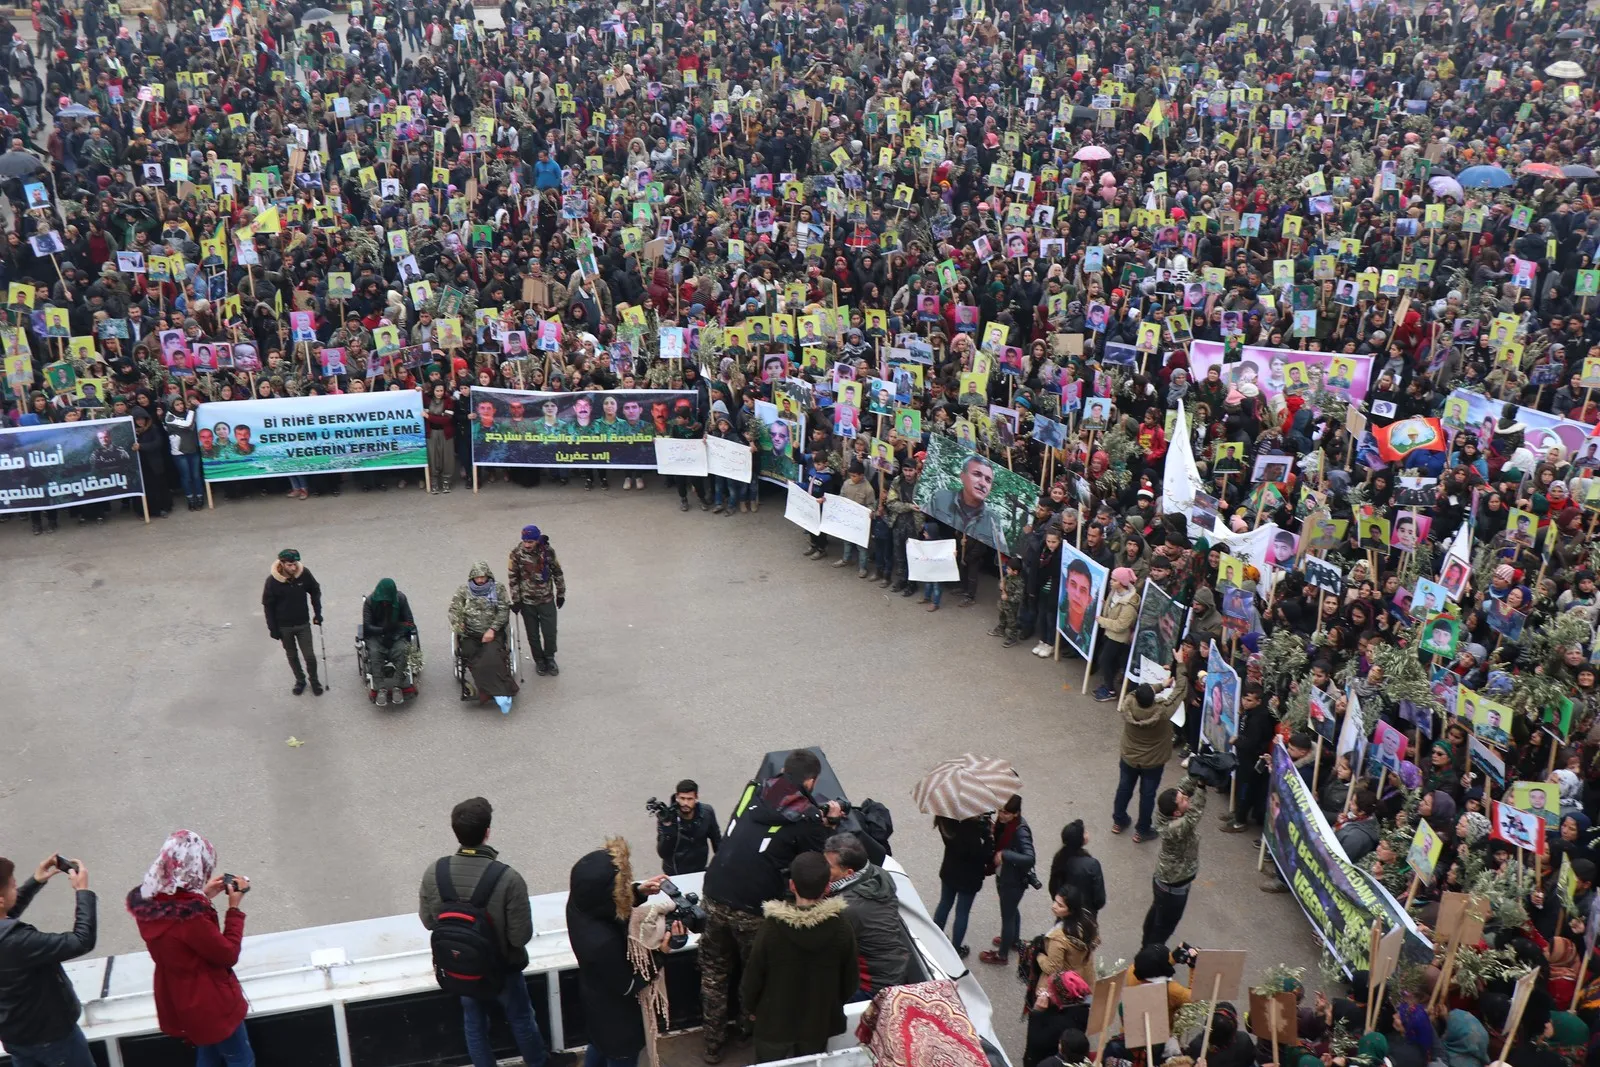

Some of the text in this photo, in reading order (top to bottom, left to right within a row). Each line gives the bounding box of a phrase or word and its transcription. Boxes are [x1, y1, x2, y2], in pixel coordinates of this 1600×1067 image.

[318, 409, 415, 425] BERXWEDANA
[259, 422, 422, 444] SERDEM Û RÛMETÊ EMÊ
[485, 430, 523, 443] سنرجع
[523, 432, 574, 446] والكرامة
[574, 433, 608, 446] العصر
[610, 433, 653, 446] مقاومة
[28, 443, 65, 468] أملنا
[555, 450, 610, 463] إلى عفرين
[47, 472, 129, 498] بالمقاومة
